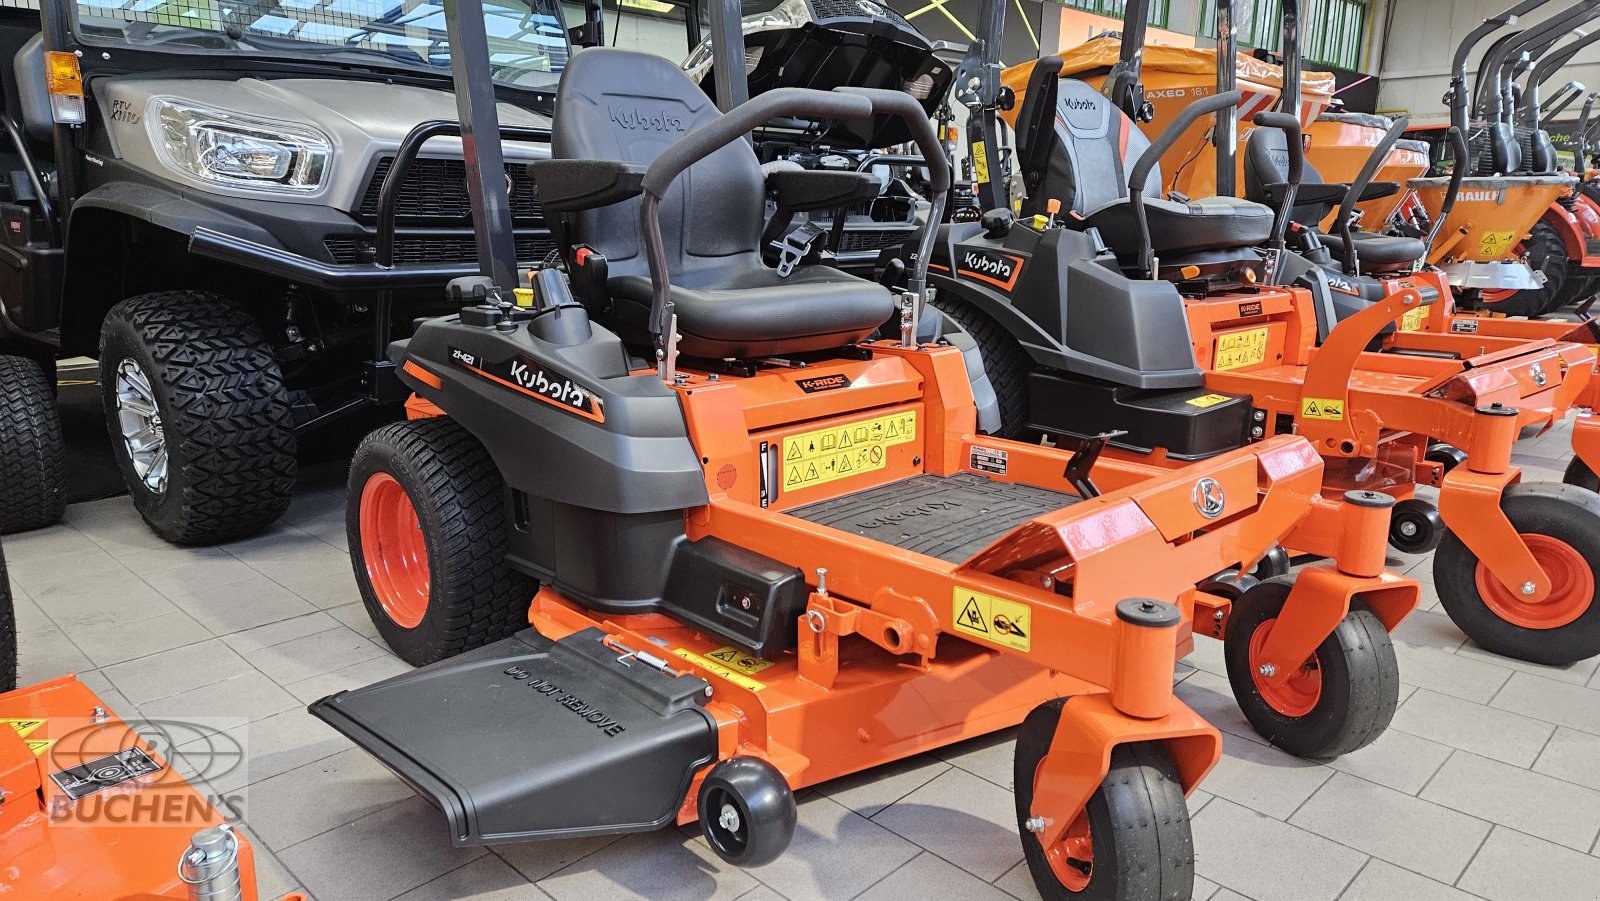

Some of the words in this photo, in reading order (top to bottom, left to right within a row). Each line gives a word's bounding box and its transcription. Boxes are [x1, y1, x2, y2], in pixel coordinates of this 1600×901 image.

[1147, 89, 1186, 99] AXEO
[113, 100, 132, 110] RTV
[1064, 98, 1096, 110] Kubota
[607, 105, 685, 132] Kubota
[965, 252, 1011, 276] Kubota
[510, 361, 584, 407] Kubota
[802, 377, 845, 388] K-RIDE
[761, 443, 767, 451] F
[504, 666, 531, 680] DO
[528, 679, 565, 696] NOT
[556, 694, 626, 737] REMOVE
